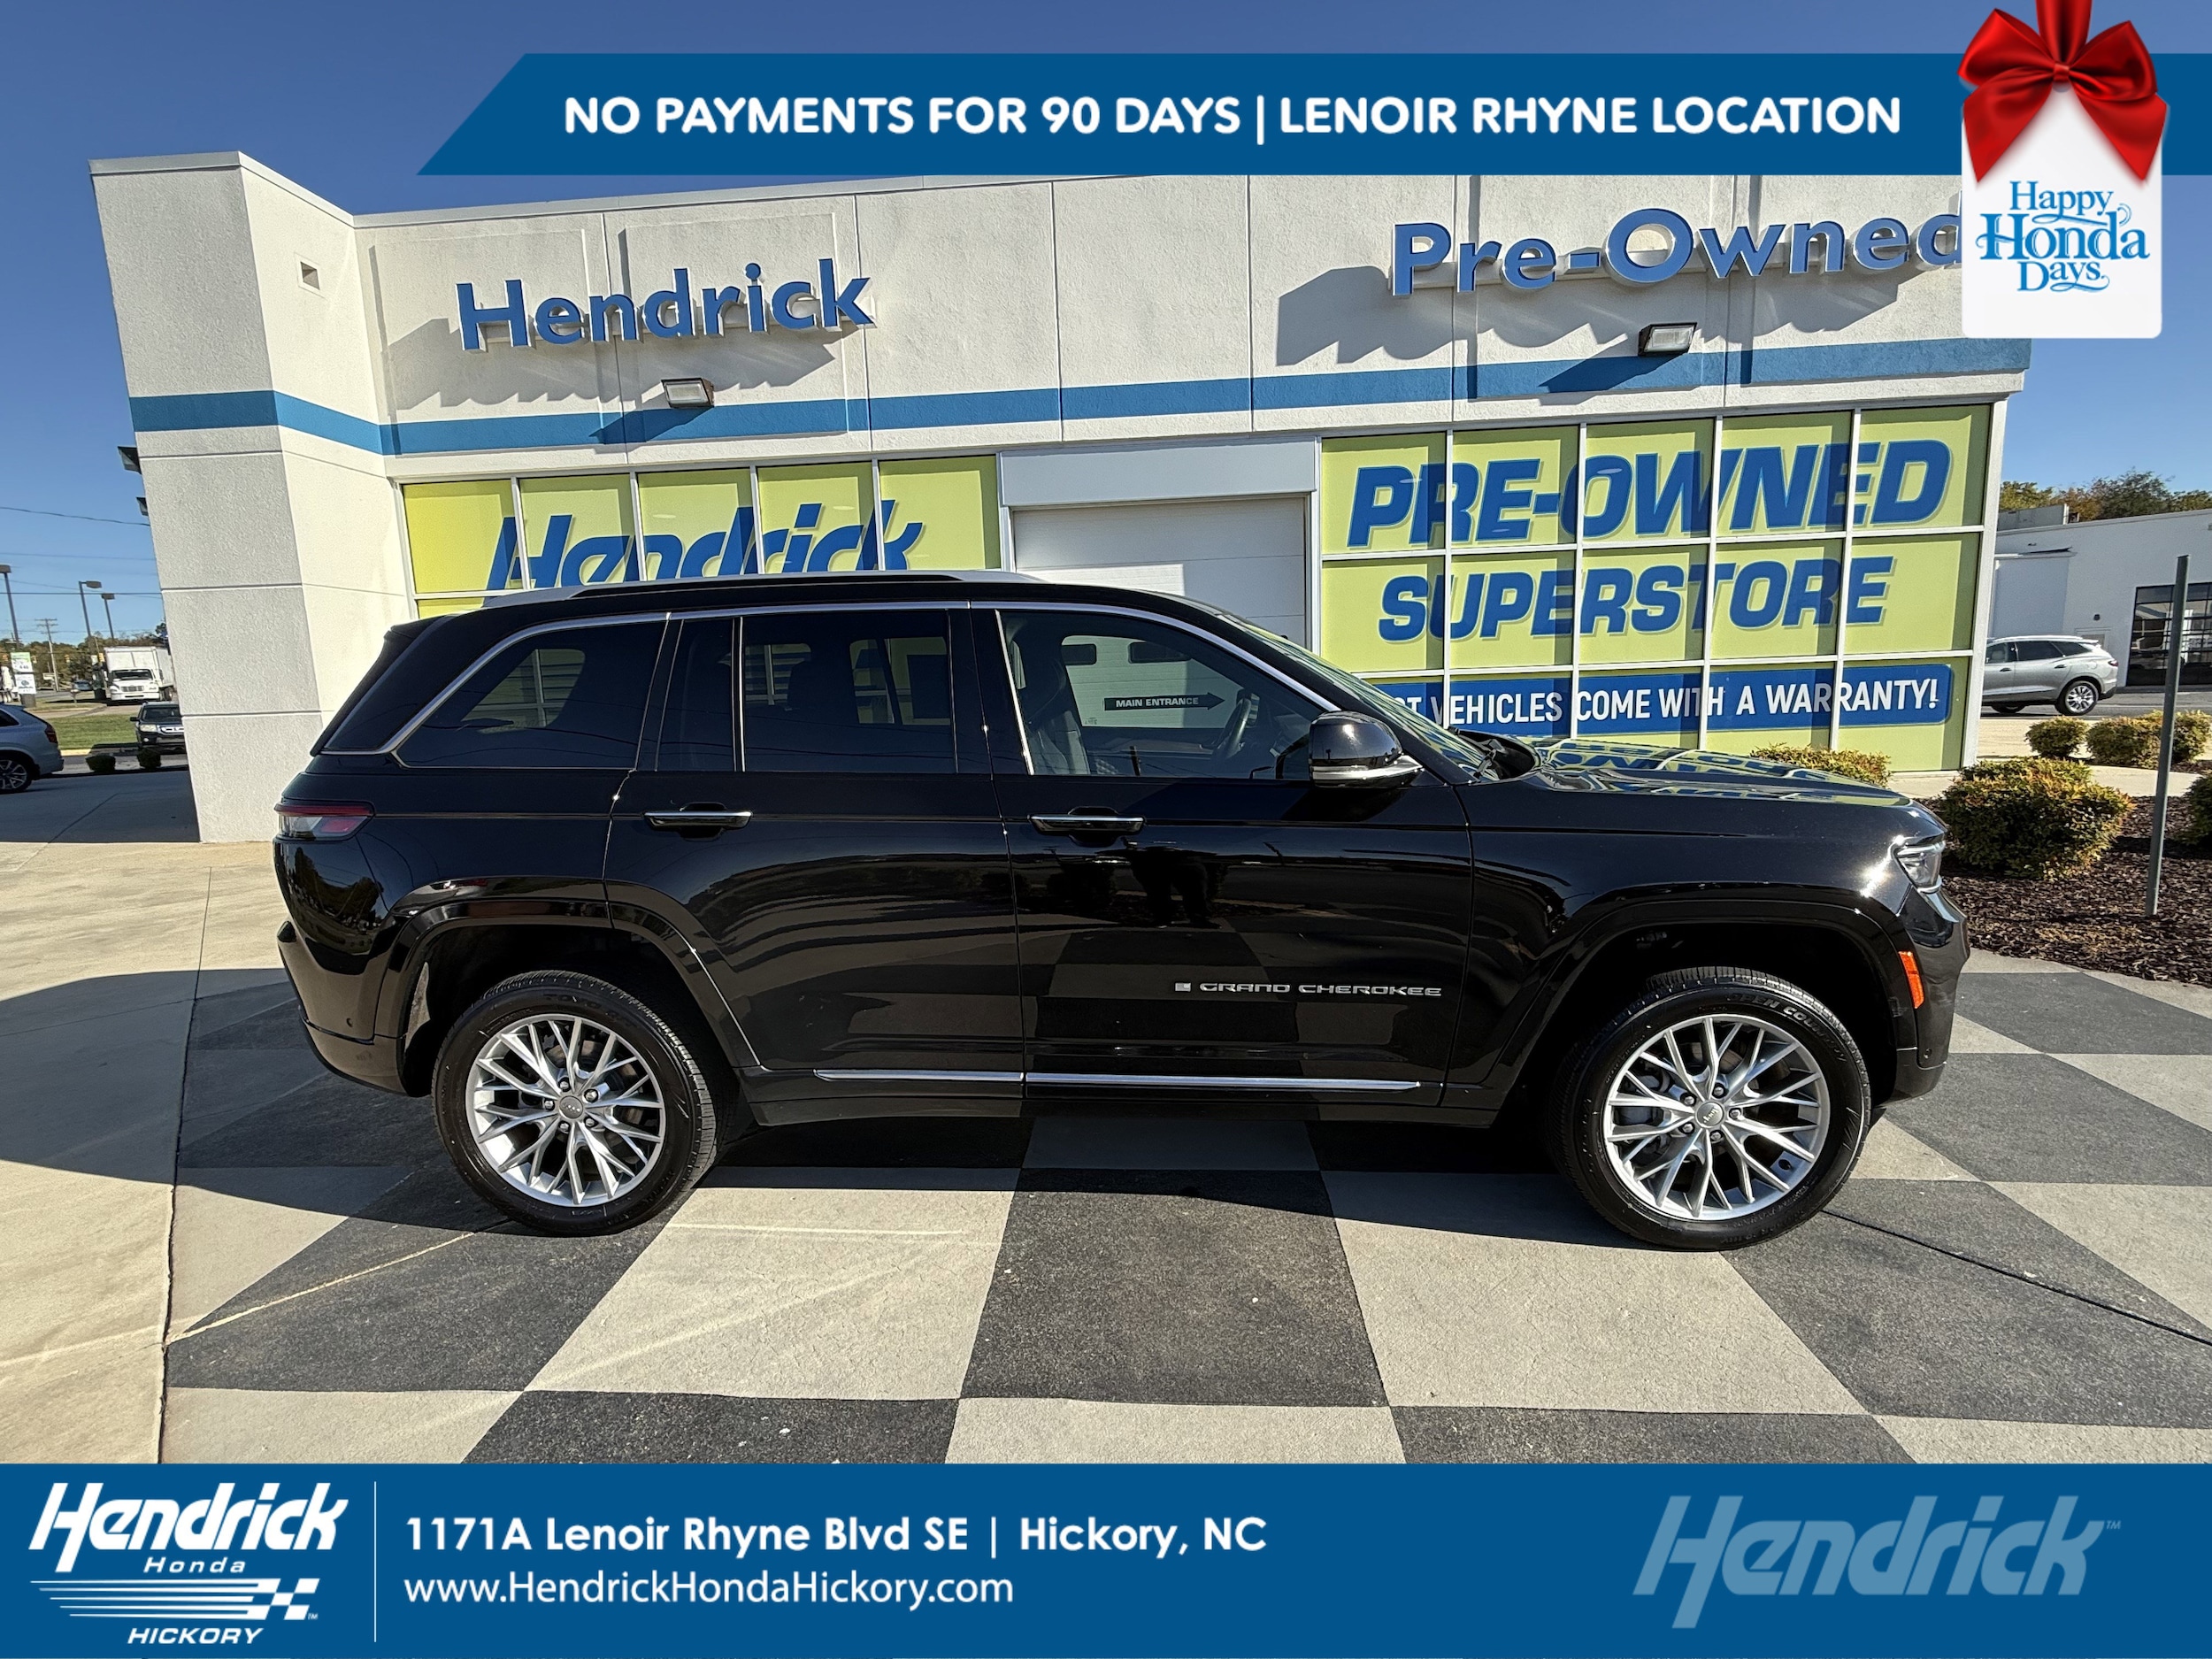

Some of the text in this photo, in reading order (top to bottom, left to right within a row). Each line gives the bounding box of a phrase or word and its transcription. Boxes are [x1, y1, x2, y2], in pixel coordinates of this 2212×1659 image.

[1391, 188, 1962, 296] Pre-Owned
[456, 257, 872, 350] Hendrick
[1346, 439, 1953, 549] PRE-OWNED
[483, 499, 924, 603] Hendrick
[1378, 556, 1894, 642] SUPERSTORE
[1116, 697, 1199, 708] MAIN ENTRANCE
[1576, 687, 1651, 721] COME
[1657, 685, 1724, 718] WITH
[1739, 683, 1755, 714] A
[1760, 676, 1940, 714] WARRANTY!
[1199, 982, 1442, 997] GRAND CHEROKEE
